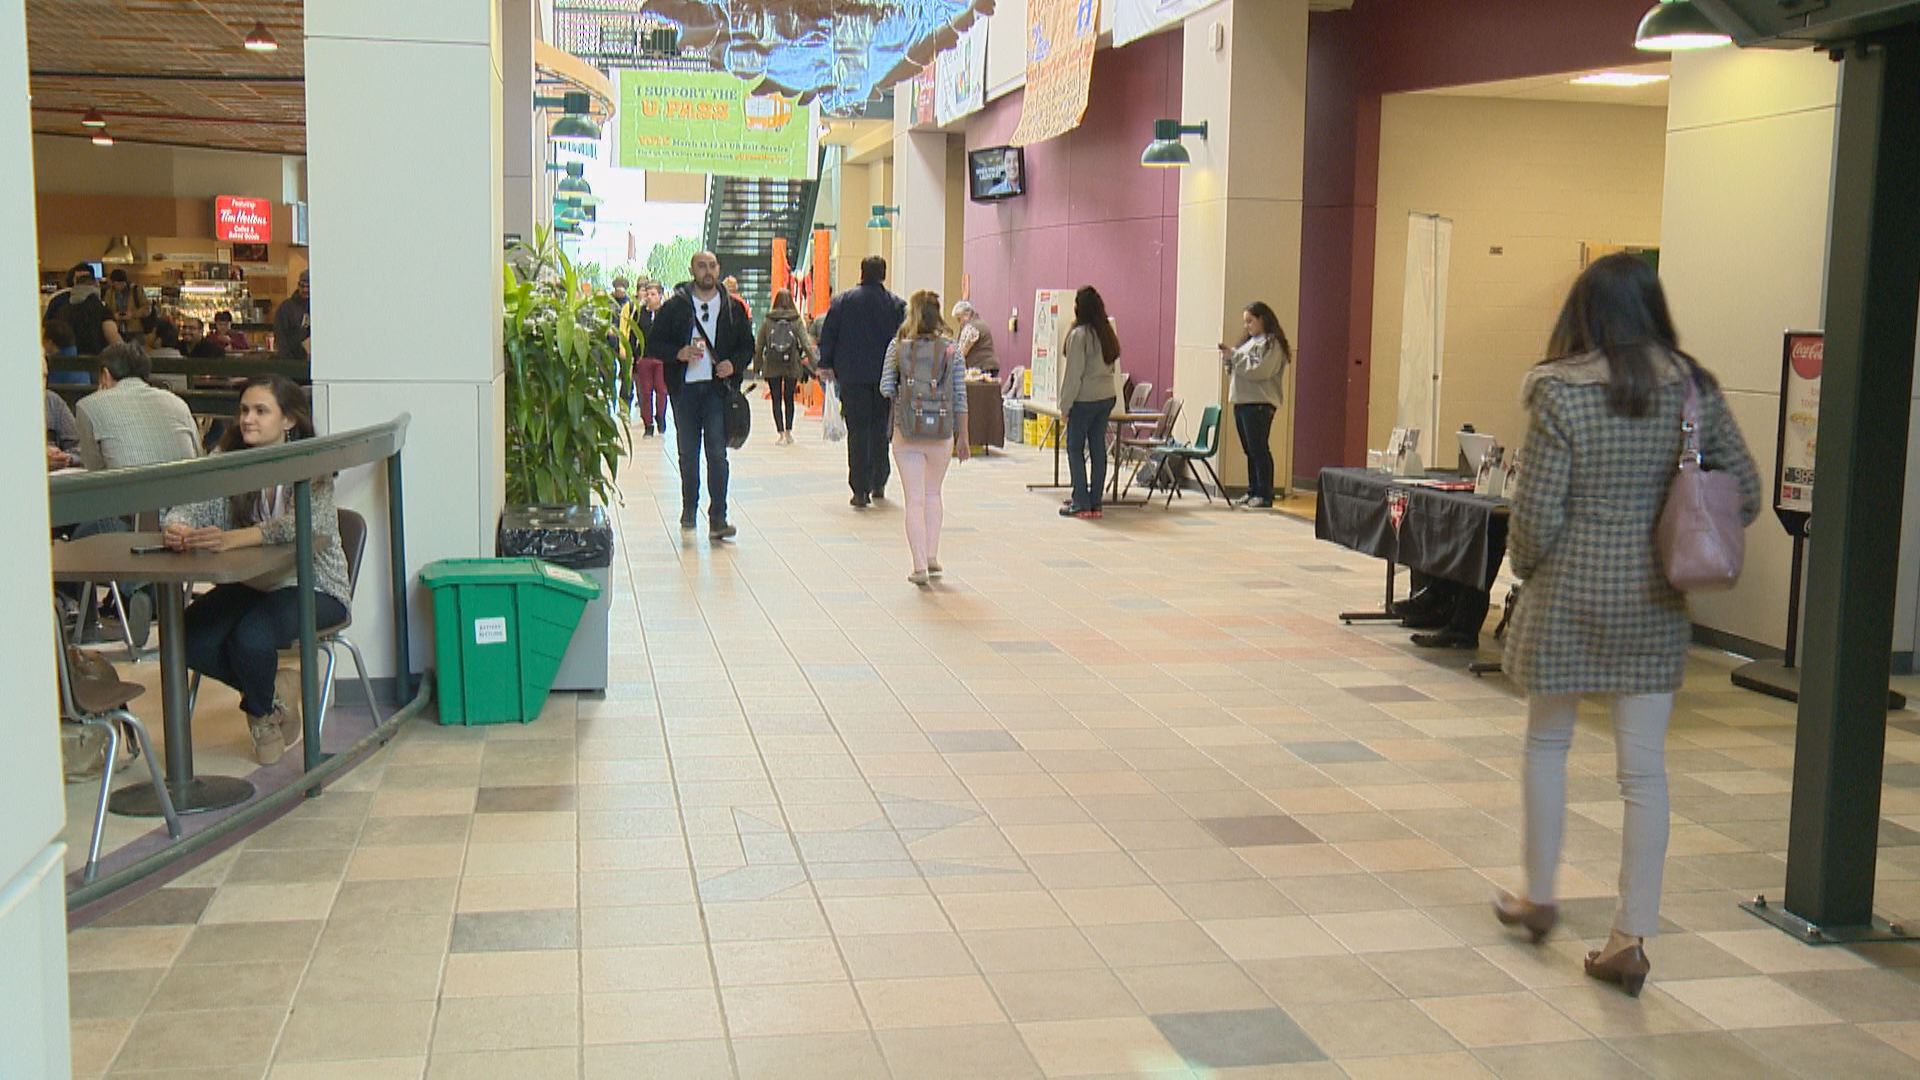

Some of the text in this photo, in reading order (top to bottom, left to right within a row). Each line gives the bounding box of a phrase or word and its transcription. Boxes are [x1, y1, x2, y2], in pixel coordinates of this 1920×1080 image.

[645, 86, 707, 98] SUPPORT
[711, 88, 737, 100] THE
[642, 99, 728, 120] U PASS
[221, 209, 267, 225] Tim Hortons
